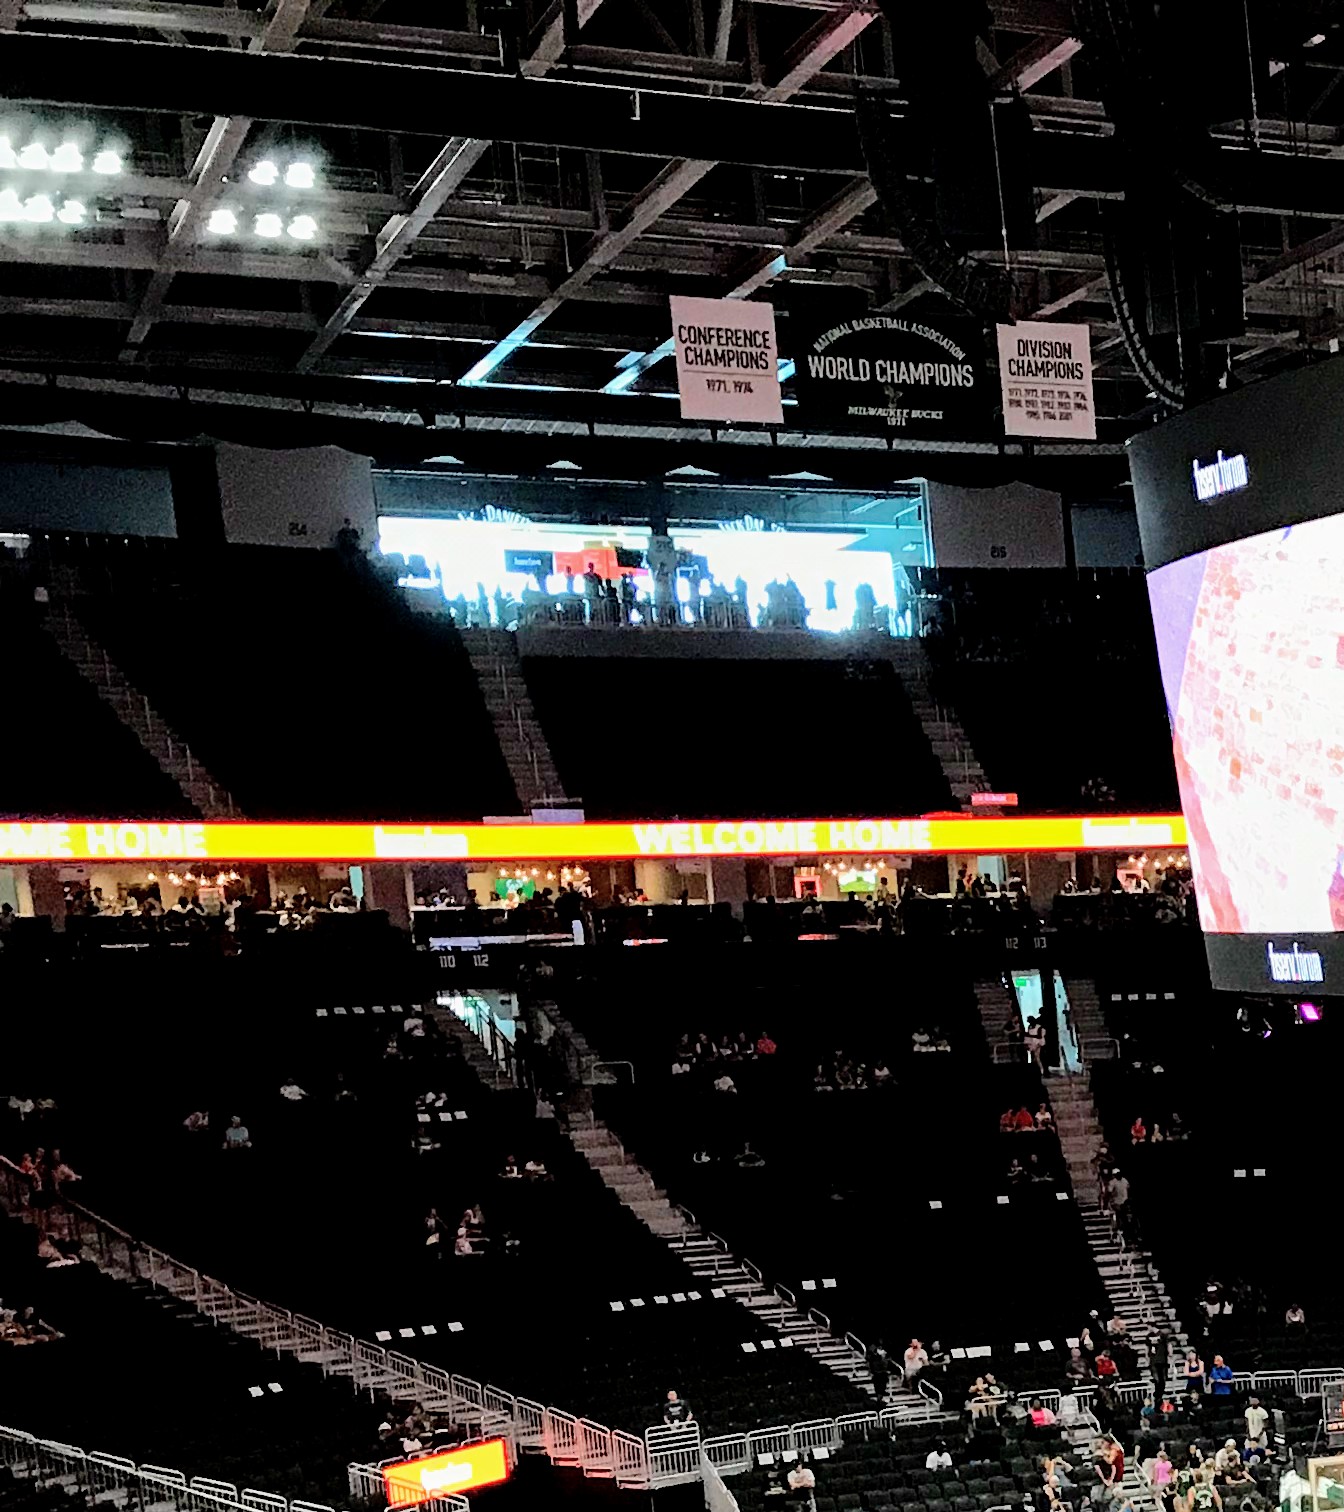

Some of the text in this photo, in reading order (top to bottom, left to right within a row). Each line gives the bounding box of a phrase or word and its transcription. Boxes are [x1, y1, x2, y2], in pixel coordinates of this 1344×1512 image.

[678, 325, 771, 350] CONFERENCE
[813, 317, 966, 360] NATIONAL BASKETBALL ASSOCIATION
[1017, 339, 1072, 359] DIVISION
[685, 347, 769, 370] CHAMPIONS
[1008, 358, 1083, 380] CHAMPIONS
[808, 354, 974, 388] WORLD CHAMPIONS
[847, 405, 943, 420] MILWAUKEE BUCKS
[887, 416, 906, 426] 1971
[86, 824, 207, 857] HOME
[633, 820, 932, 854] WELCOME HOME
